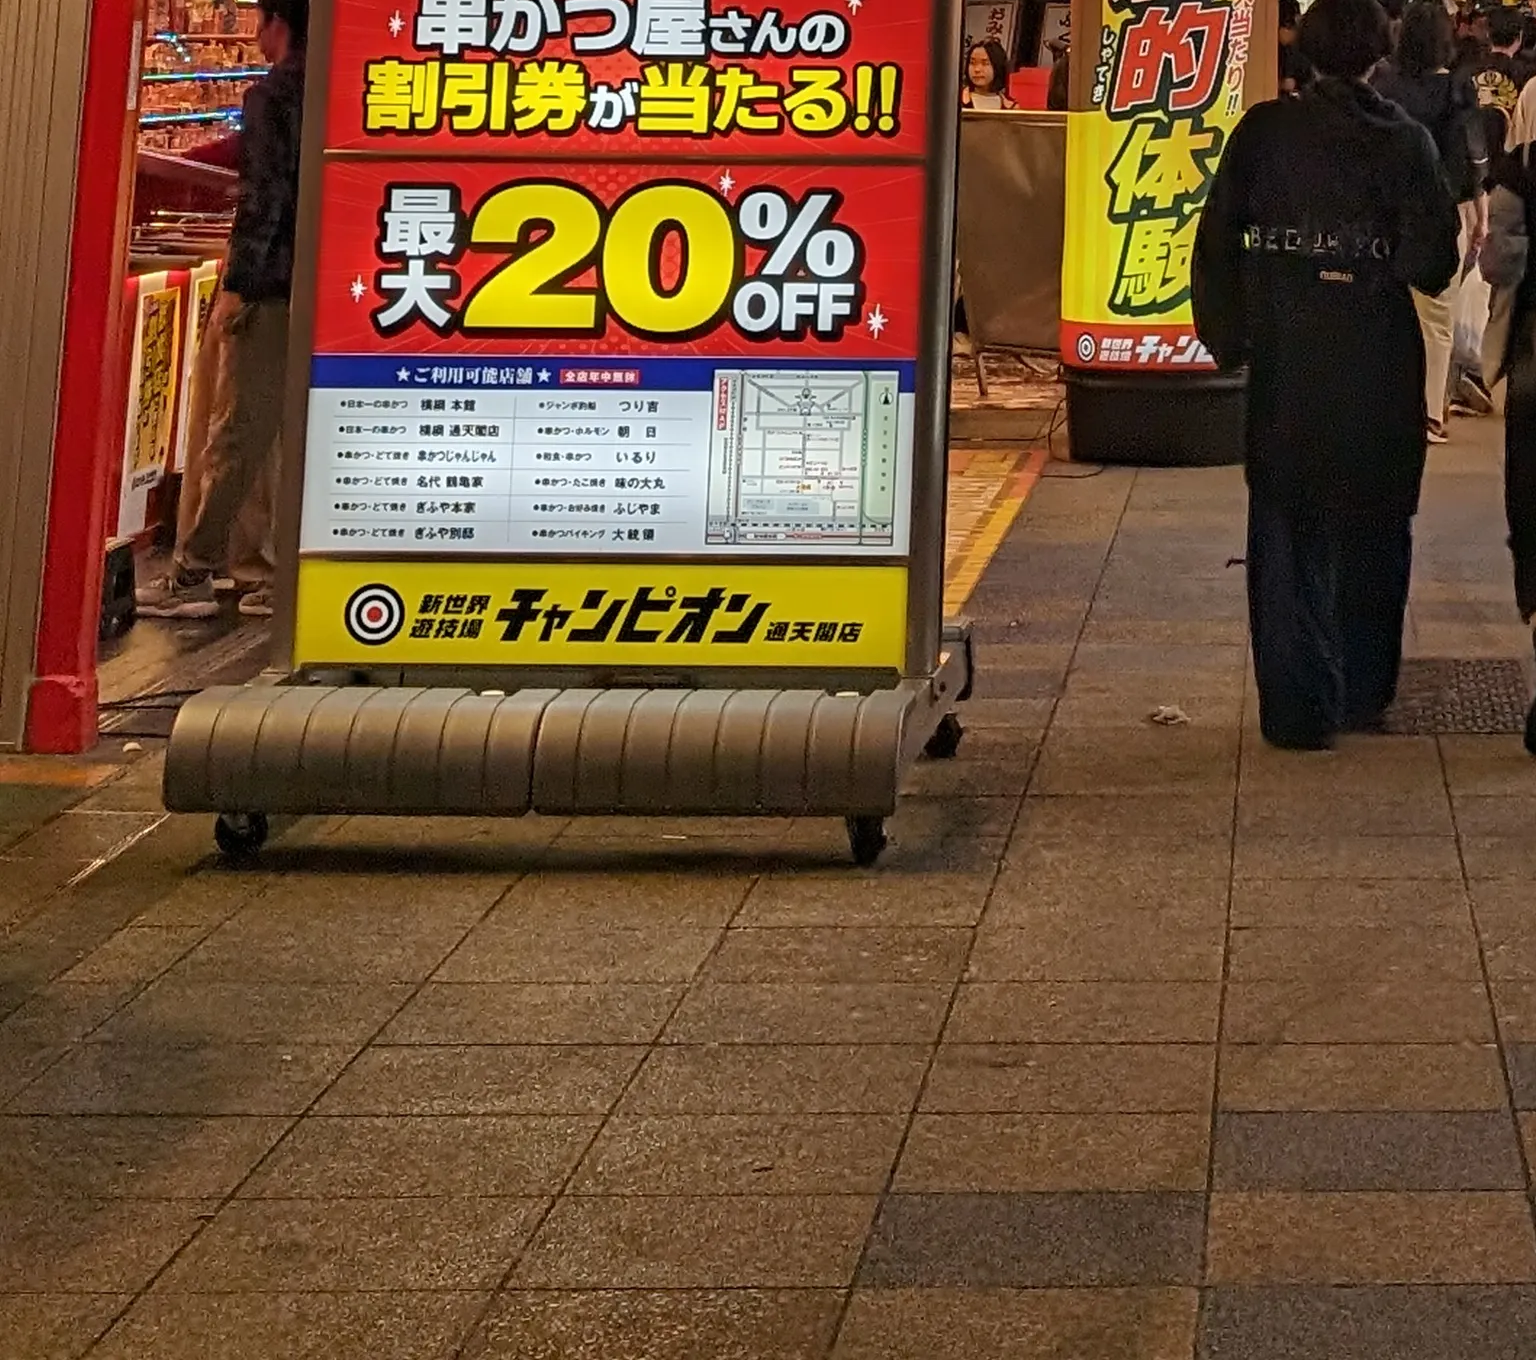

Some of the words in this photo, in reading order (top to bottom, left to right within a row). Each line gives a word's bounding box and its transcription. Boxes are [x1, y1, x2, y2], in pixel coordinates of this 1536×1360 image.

[365, 60, 898, 134] 割引券が当たる!!
[377, 189, 457, 329] 最大
[462, 184, 736, 333] 20
[739, 191, 855, 279] %
[733, 282, 855, 332] OFF
[414, 366, 533, 384] ご利用可能店舗
[409, 618, 484, 641] 遊技場
[418, 593, 491, 616] 新世界
[494, 587, 773, 646] チャンピオン
[764, 620, 863, 644] 通天閣店
